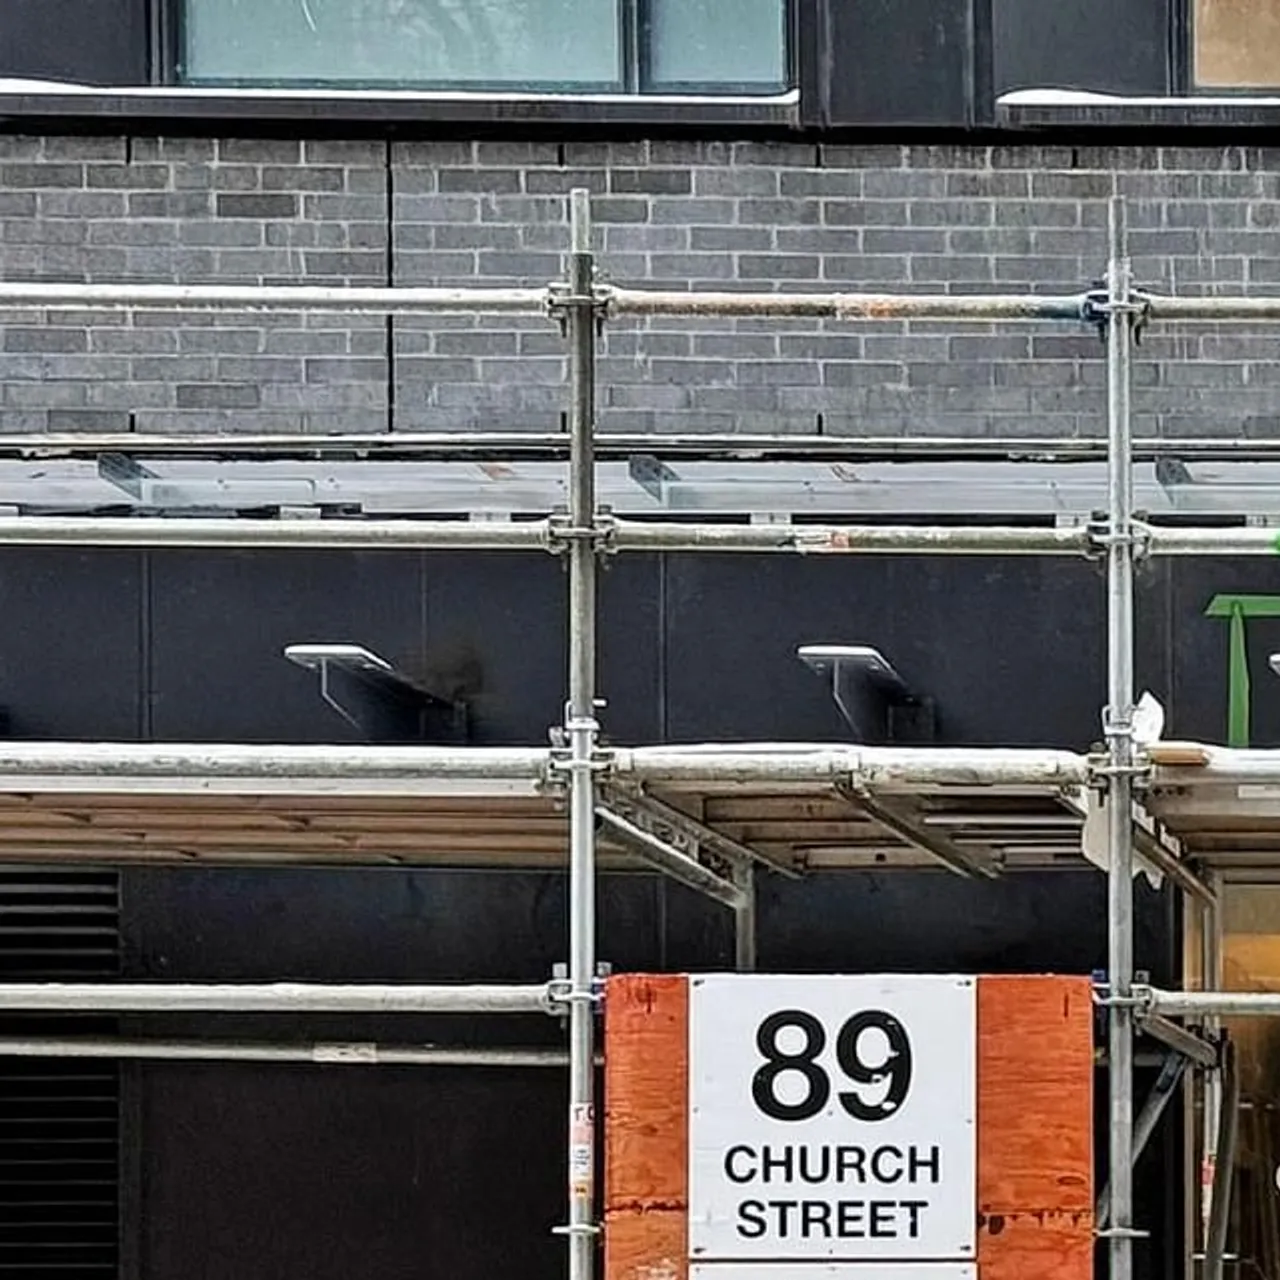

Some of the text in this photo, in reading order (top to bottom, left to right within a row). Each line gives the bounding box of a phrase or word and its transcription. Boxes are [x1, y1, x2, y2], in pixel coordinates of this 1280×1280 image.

[752, 1009, 914, 1122] 89
[723, 1146, 940, 1184] CHURCH
[736, 1200, 929, 1239] STREET
